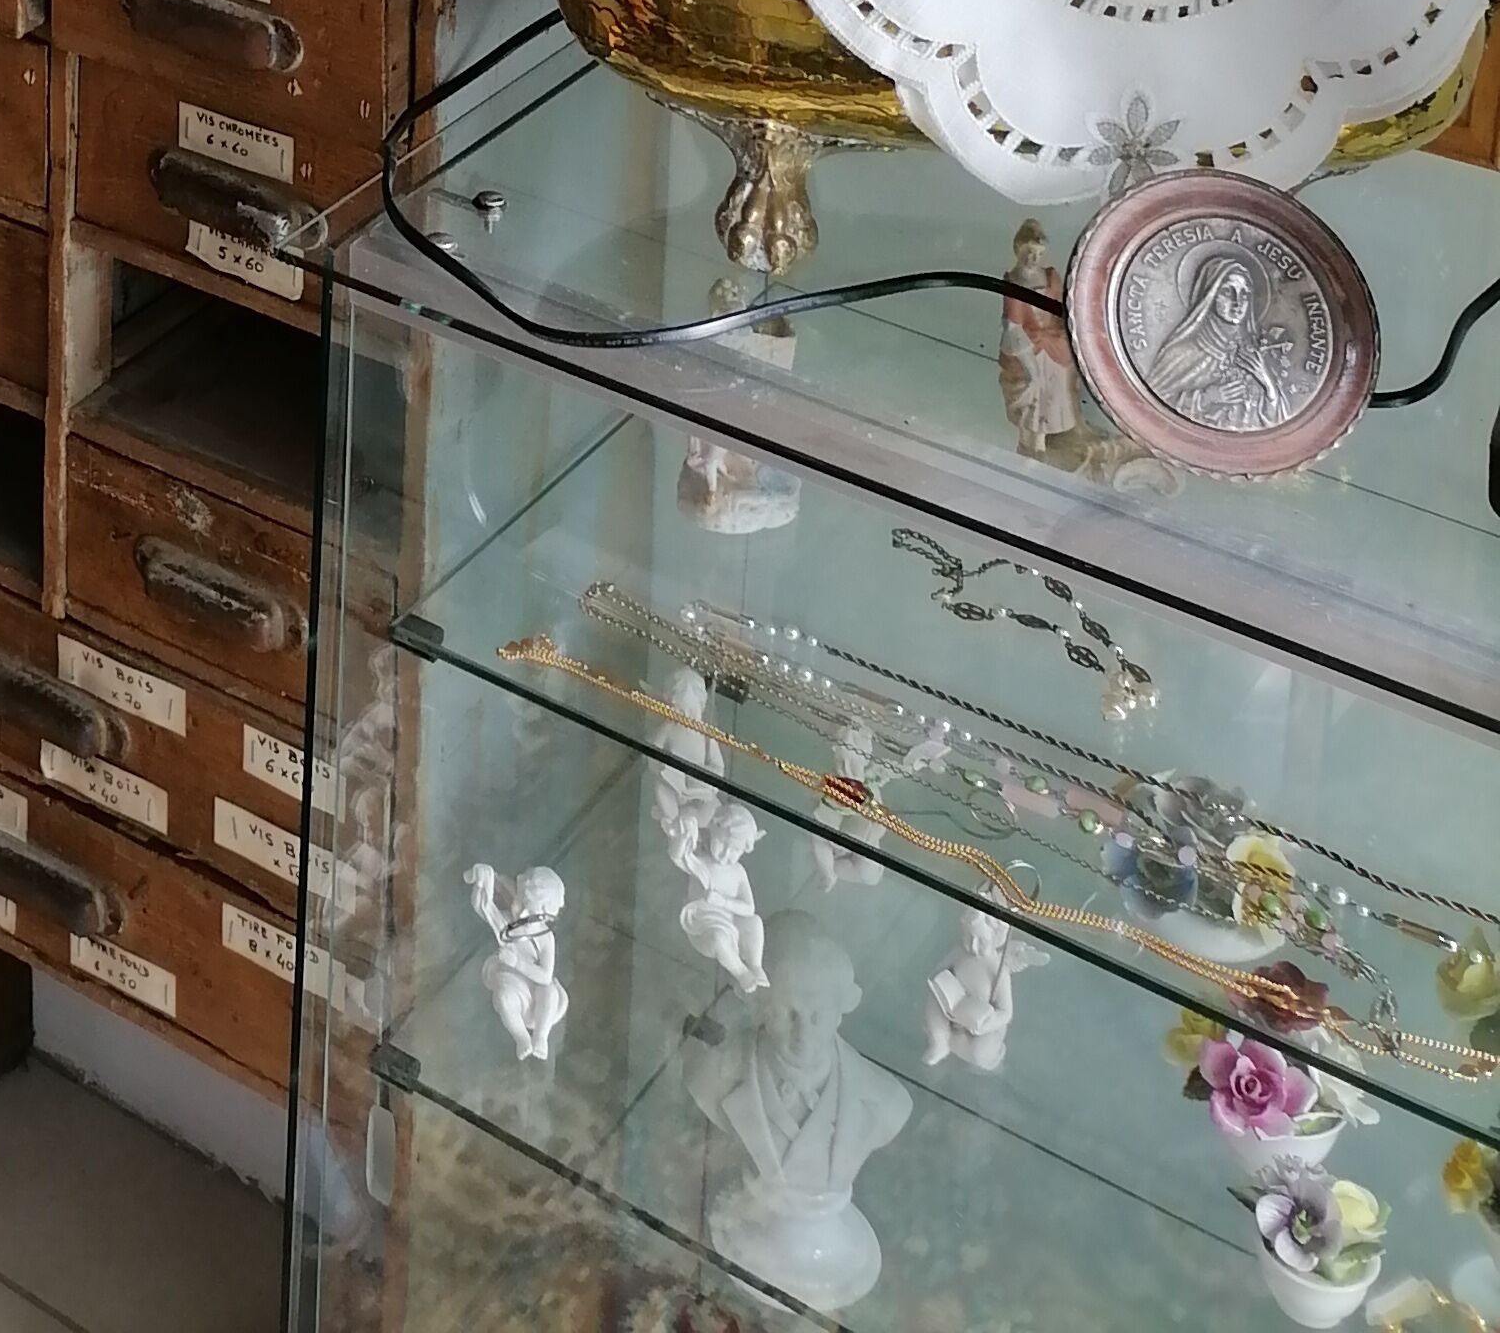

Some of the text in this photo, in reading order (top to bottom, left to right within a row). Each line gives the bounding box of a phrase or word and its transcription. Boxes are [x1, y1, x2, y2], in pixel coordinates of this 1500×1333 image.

[196, 112, 215, 128] VIS
[231, 141, 249, 158] 60
[218, 246, 264, 274] 5 60
[1127, 225, 1327, 375] SANCTA TERESIA A JESU INFANTE
[82, 647, 105, 670] VIS
[257, 734, 279, 754] VIS
[265, 759, 275, 774] 6
[100, 787, 119, 805] 40
[249, 823, 330, 874] VIS BIS
[236, 913, 319, 965] TIRE FOD
[276, 955, 295, 972] 40
